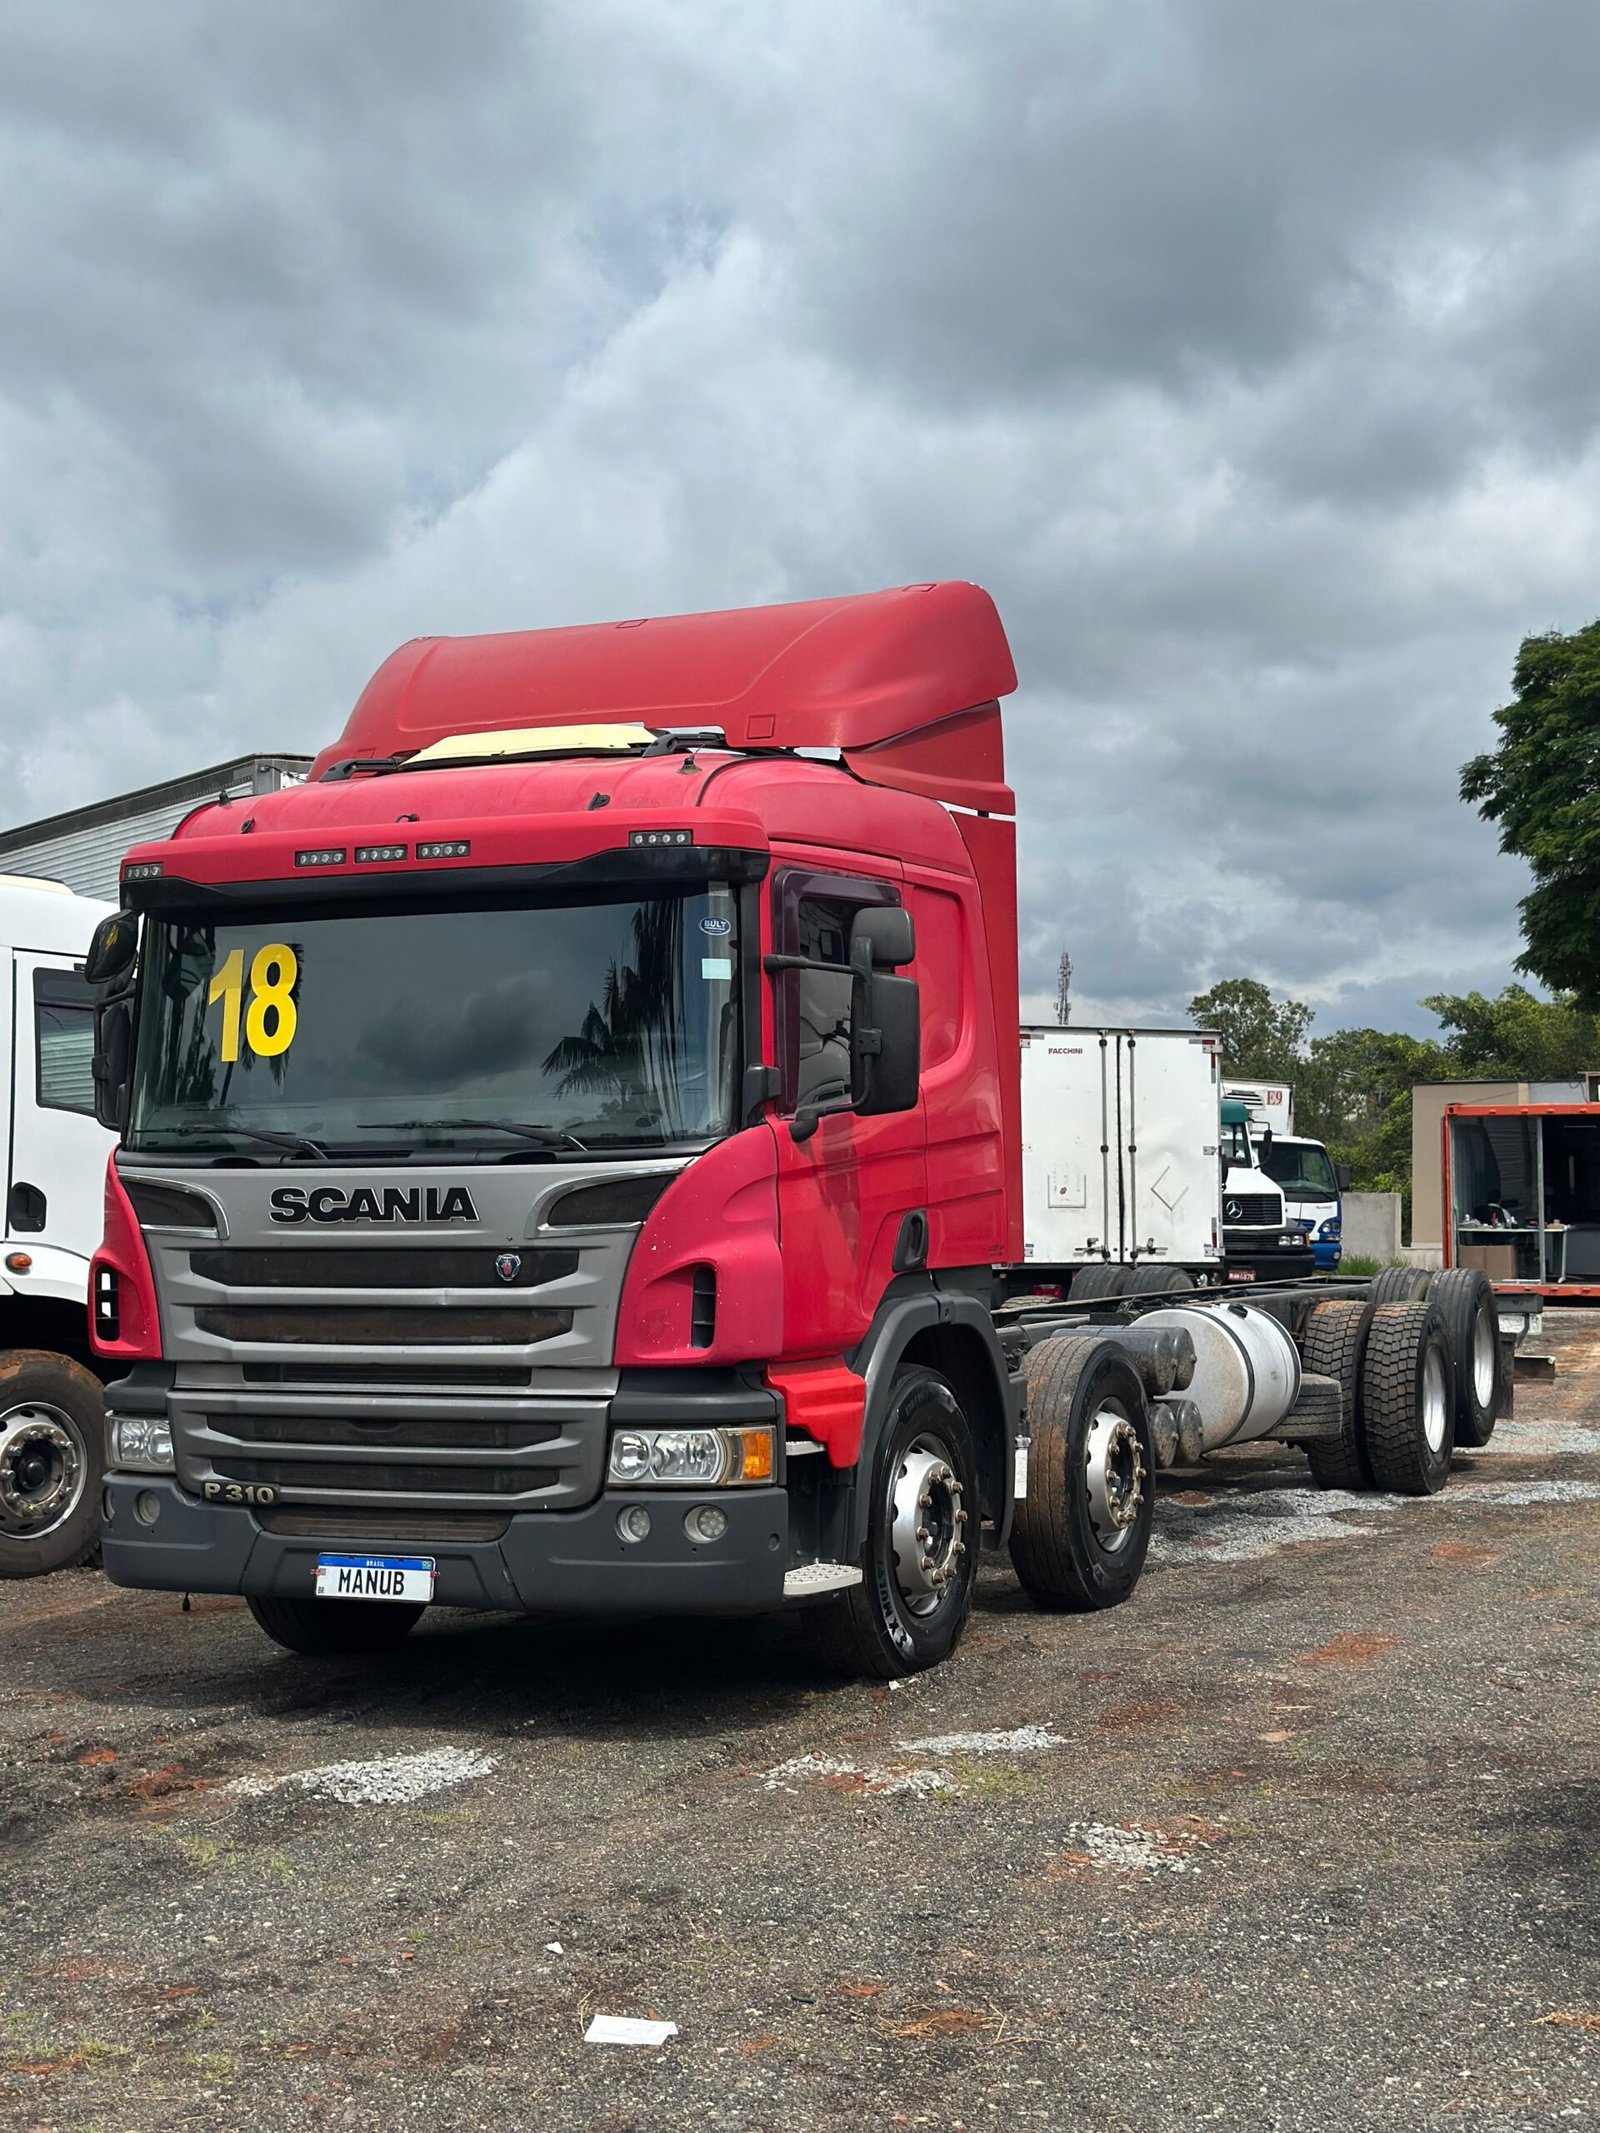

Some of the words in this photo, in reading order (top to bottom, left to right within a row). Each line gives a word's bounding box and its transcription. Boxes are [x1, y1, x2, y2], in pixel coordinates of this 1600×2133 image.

[208, 943, 298, 1062] 18
[1048, 1047, 1083, 1055] FACCHINI
[1266, 1090, 1283, 1106] E9
[269, 1186, 482, 1224] SCANIA
[204, 1482, 221, 1499] P
[225, 1484, 274, 1503] 310
[365, 1559, 385, 1568] BRASIL
[338, 1568, 405, 1596] MANUB
